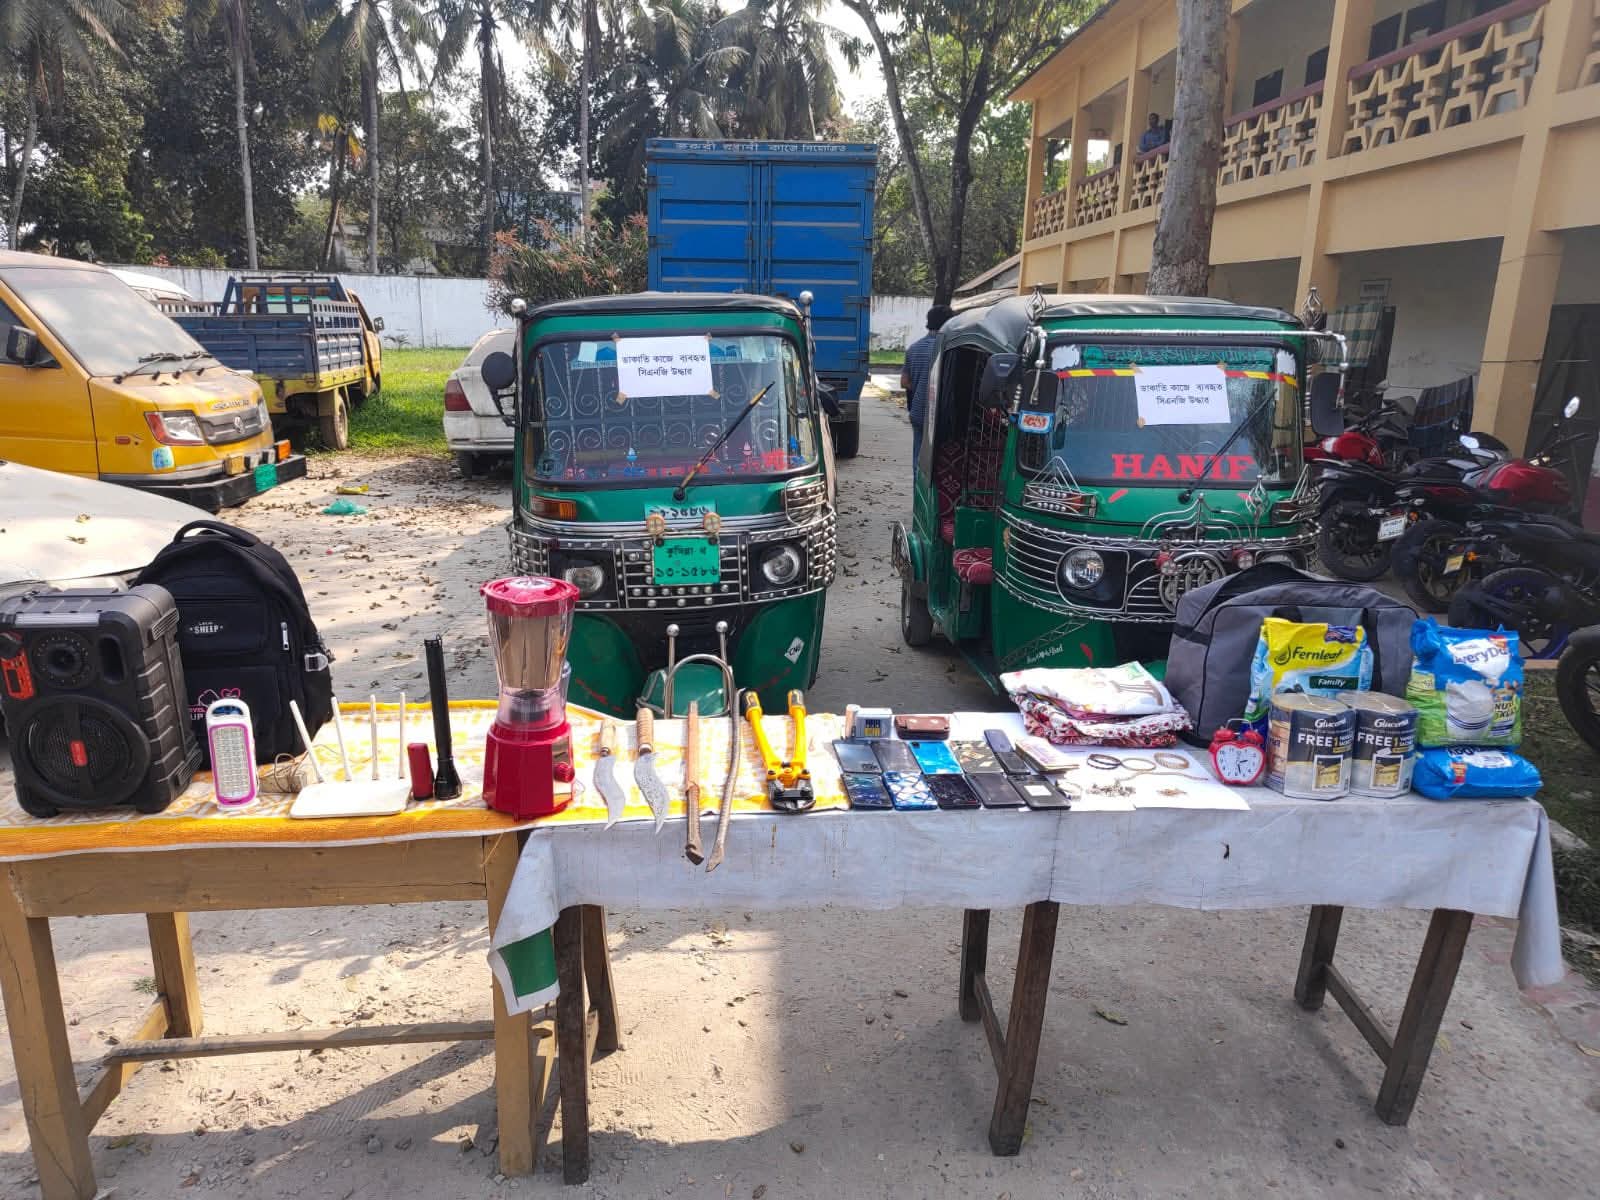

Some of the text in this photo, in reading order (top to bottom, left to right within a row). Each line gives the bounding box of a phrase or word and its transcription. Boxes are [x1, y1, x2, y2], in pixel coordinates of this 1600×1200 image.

[622, 353, 650, 364] ডাকাতি
[653, 355, 674, 363] কাজে
[638, 366, 668, 377] সিএনজি
[1139, 382, 1168, 392] ডাকাতি
[1169, 384, 1191, 392] কাজে
[1156, 395, 1186, 405] সিএনজি
[1111, 453, 1255, 480] HANIF
[194, 625, 219, 634] SHEEP
[1293, 647, 1344, 661] Fernleaf
[1318, 679, 1345, 687] Family
[1297, 732, 1333, 747] FREE
[1357, 731, 1392, 747] FREE
